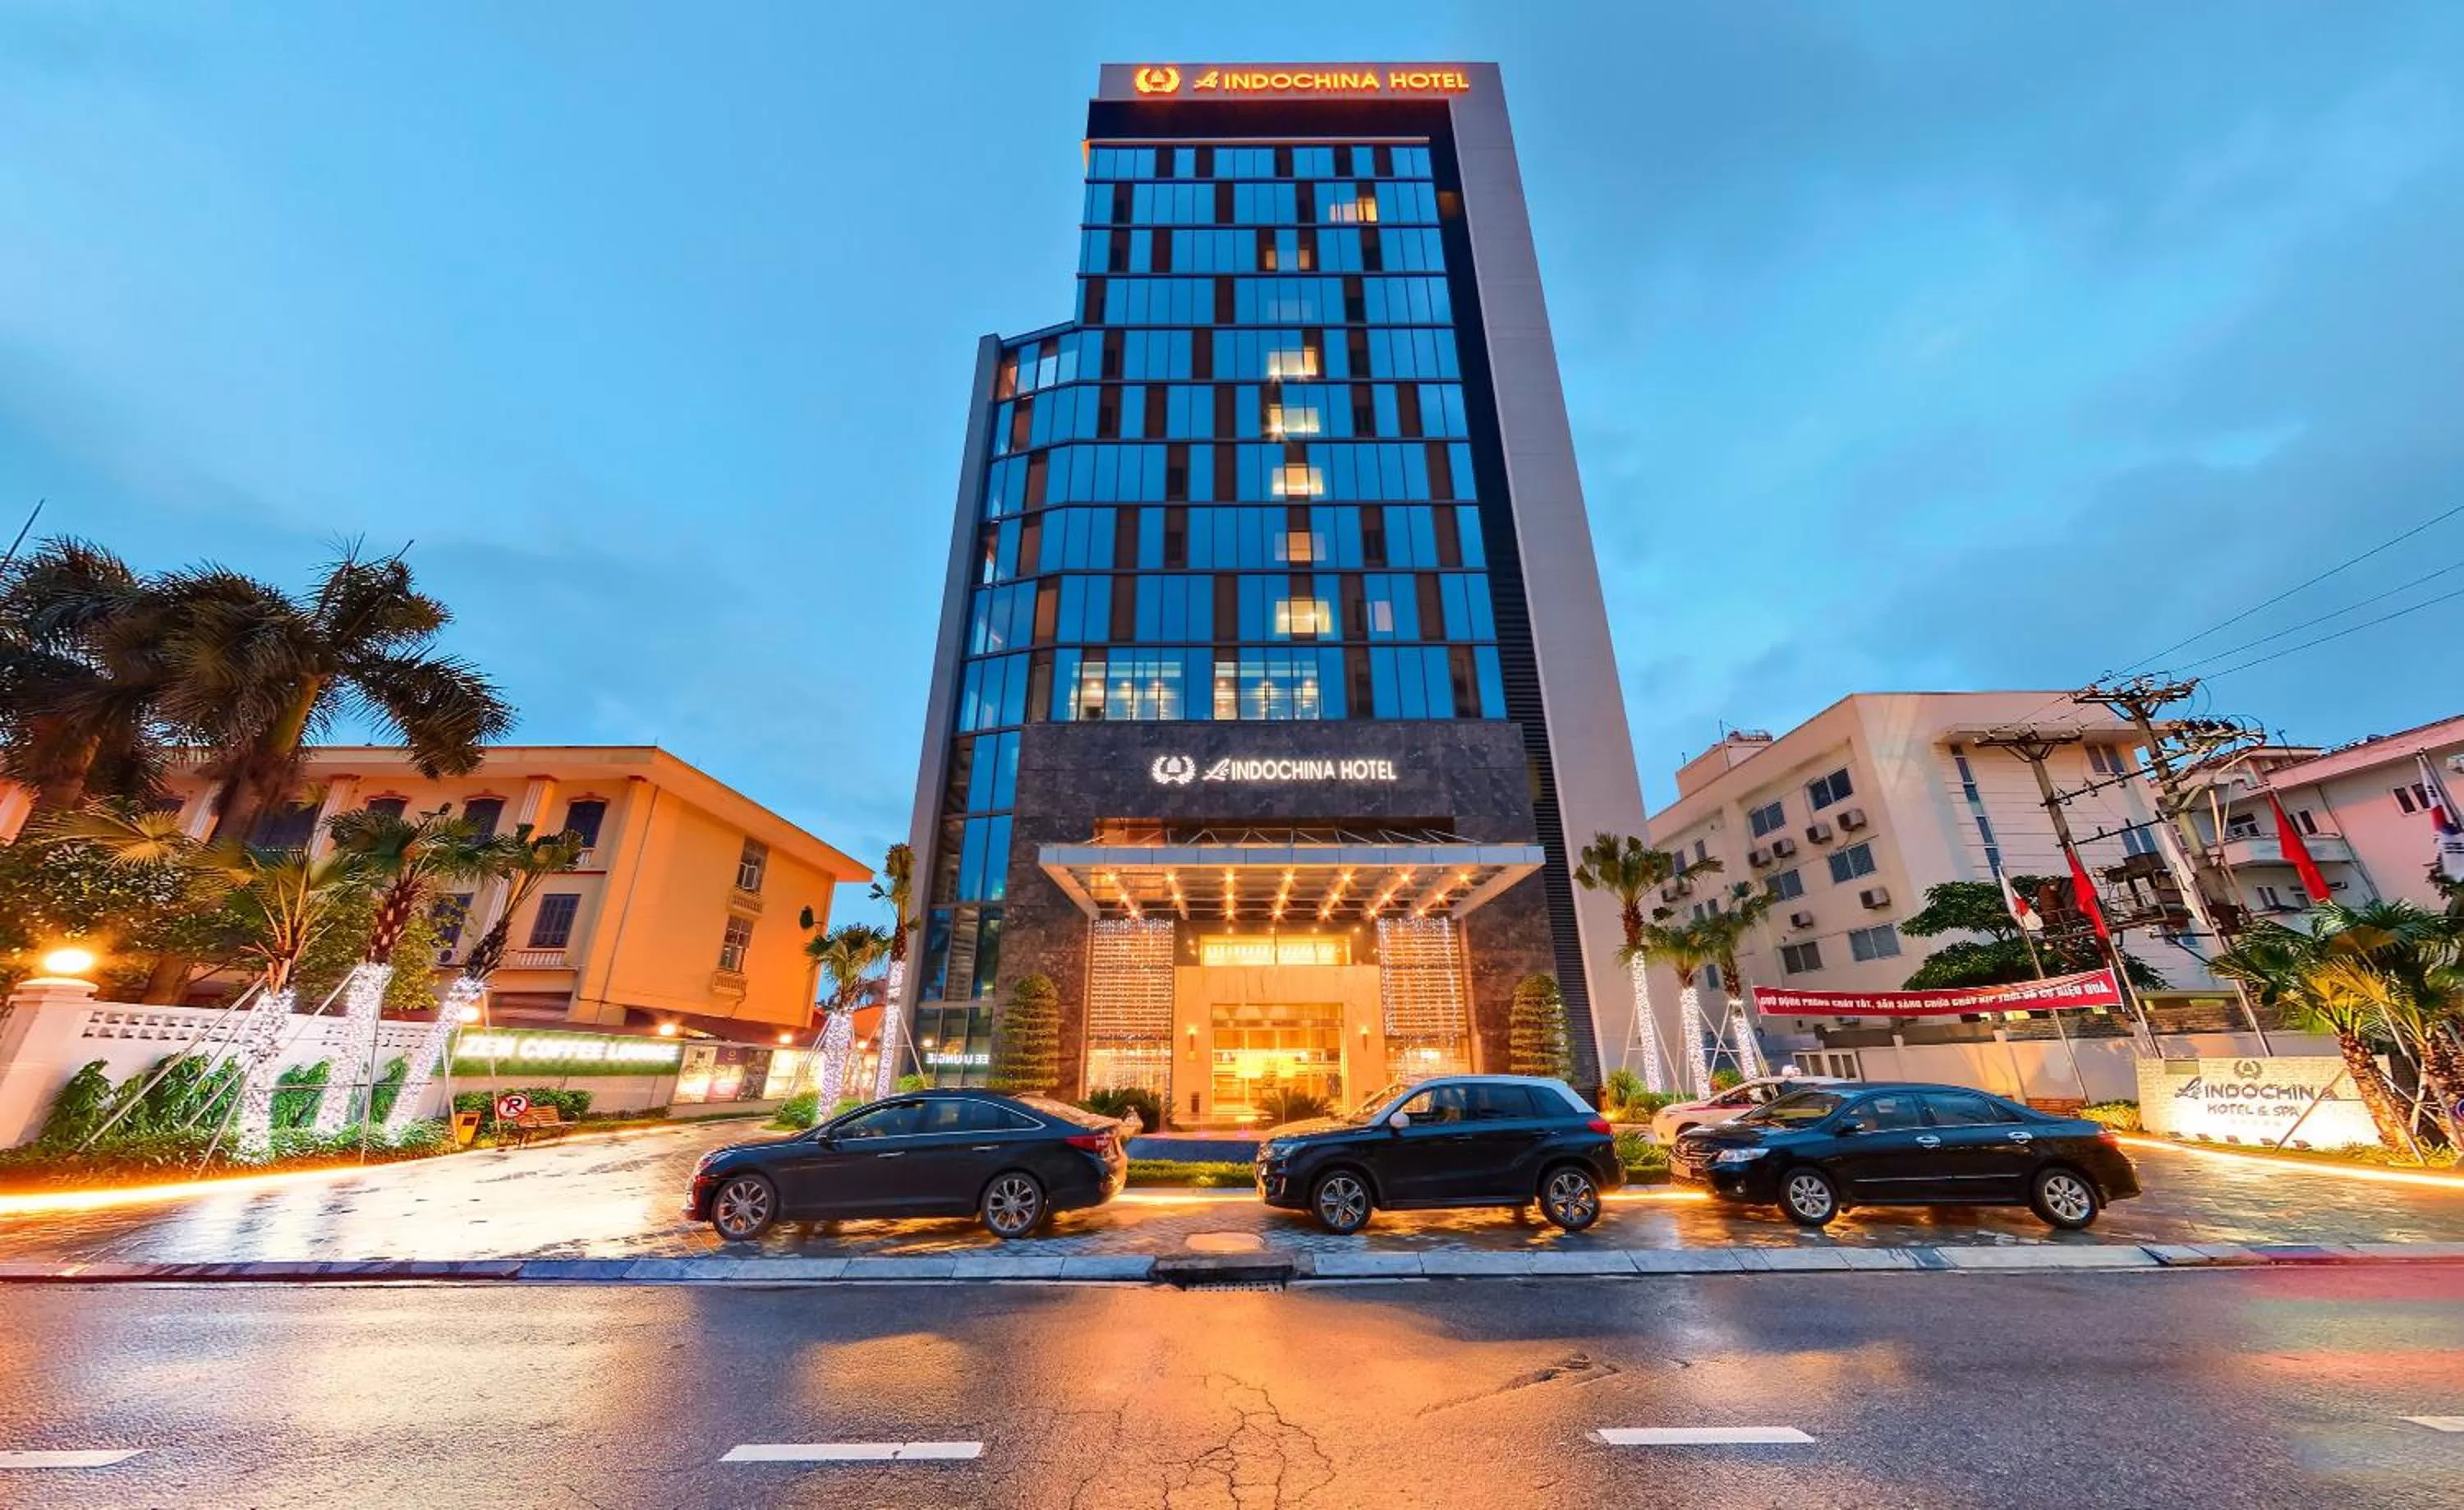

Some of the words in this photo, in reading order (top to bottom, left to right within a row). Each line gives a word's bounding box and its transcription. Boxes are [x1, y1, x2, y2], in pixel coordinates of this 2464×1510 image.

[1224, 72, 1381, 90] INDOCHINA
[1389, 71, 1470, 90] HOTEL
[1202, 757, 1230, 781] Le
[1231, 759, 1335, 781] INDOCHINA
[1340, 759, 1397, 781] HOTEL
[458, 1035, 516, 1057] ZEN
[519, 1038, 605, 1060] COFFEE
[2207, 1103, 2254, 1116] HOTEL
[2273, 1105, 2301, 1117] SPA
